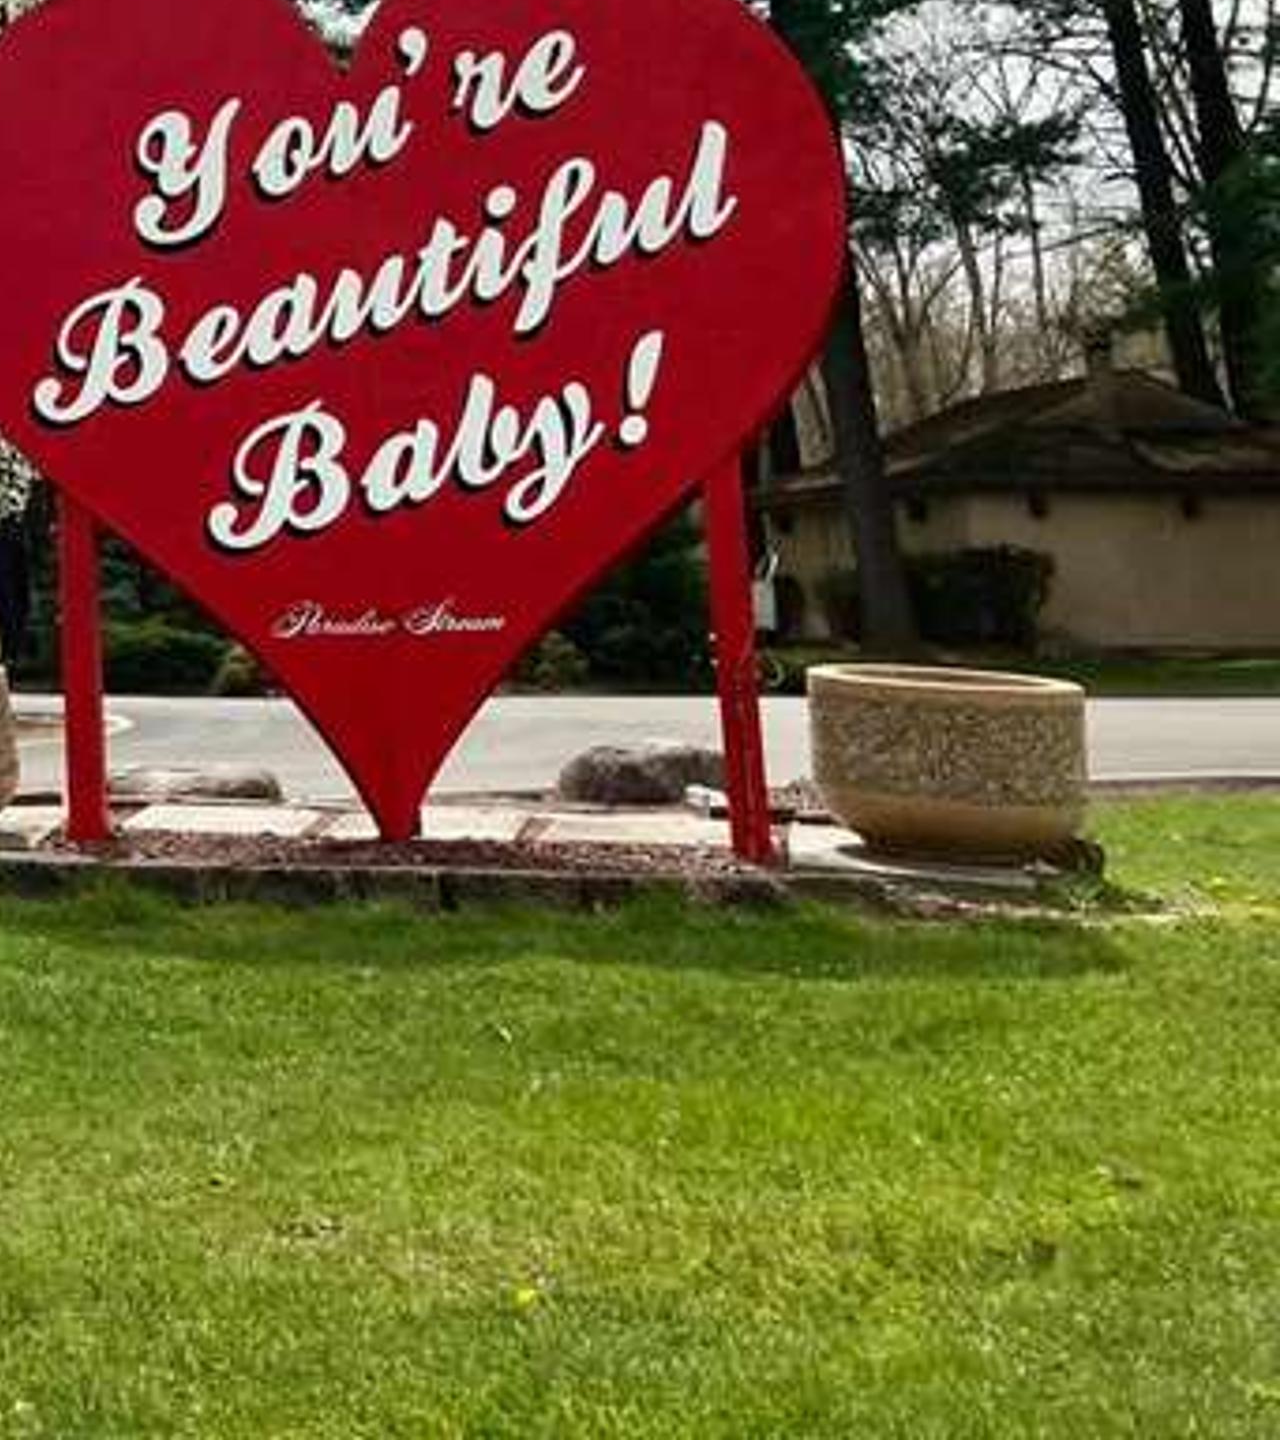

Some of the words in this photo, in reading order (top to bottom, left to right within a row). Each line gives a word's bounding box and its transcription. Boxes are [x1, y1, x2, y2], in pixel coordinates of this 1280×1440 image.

[133, 26, 585, 246] You're
[33, 120, 738, 423] Beautiful
[207, 330, 664, 550] Baby!
[272, 599, 395, 637] Paradise
[402, 596, 505, 635] Stream
